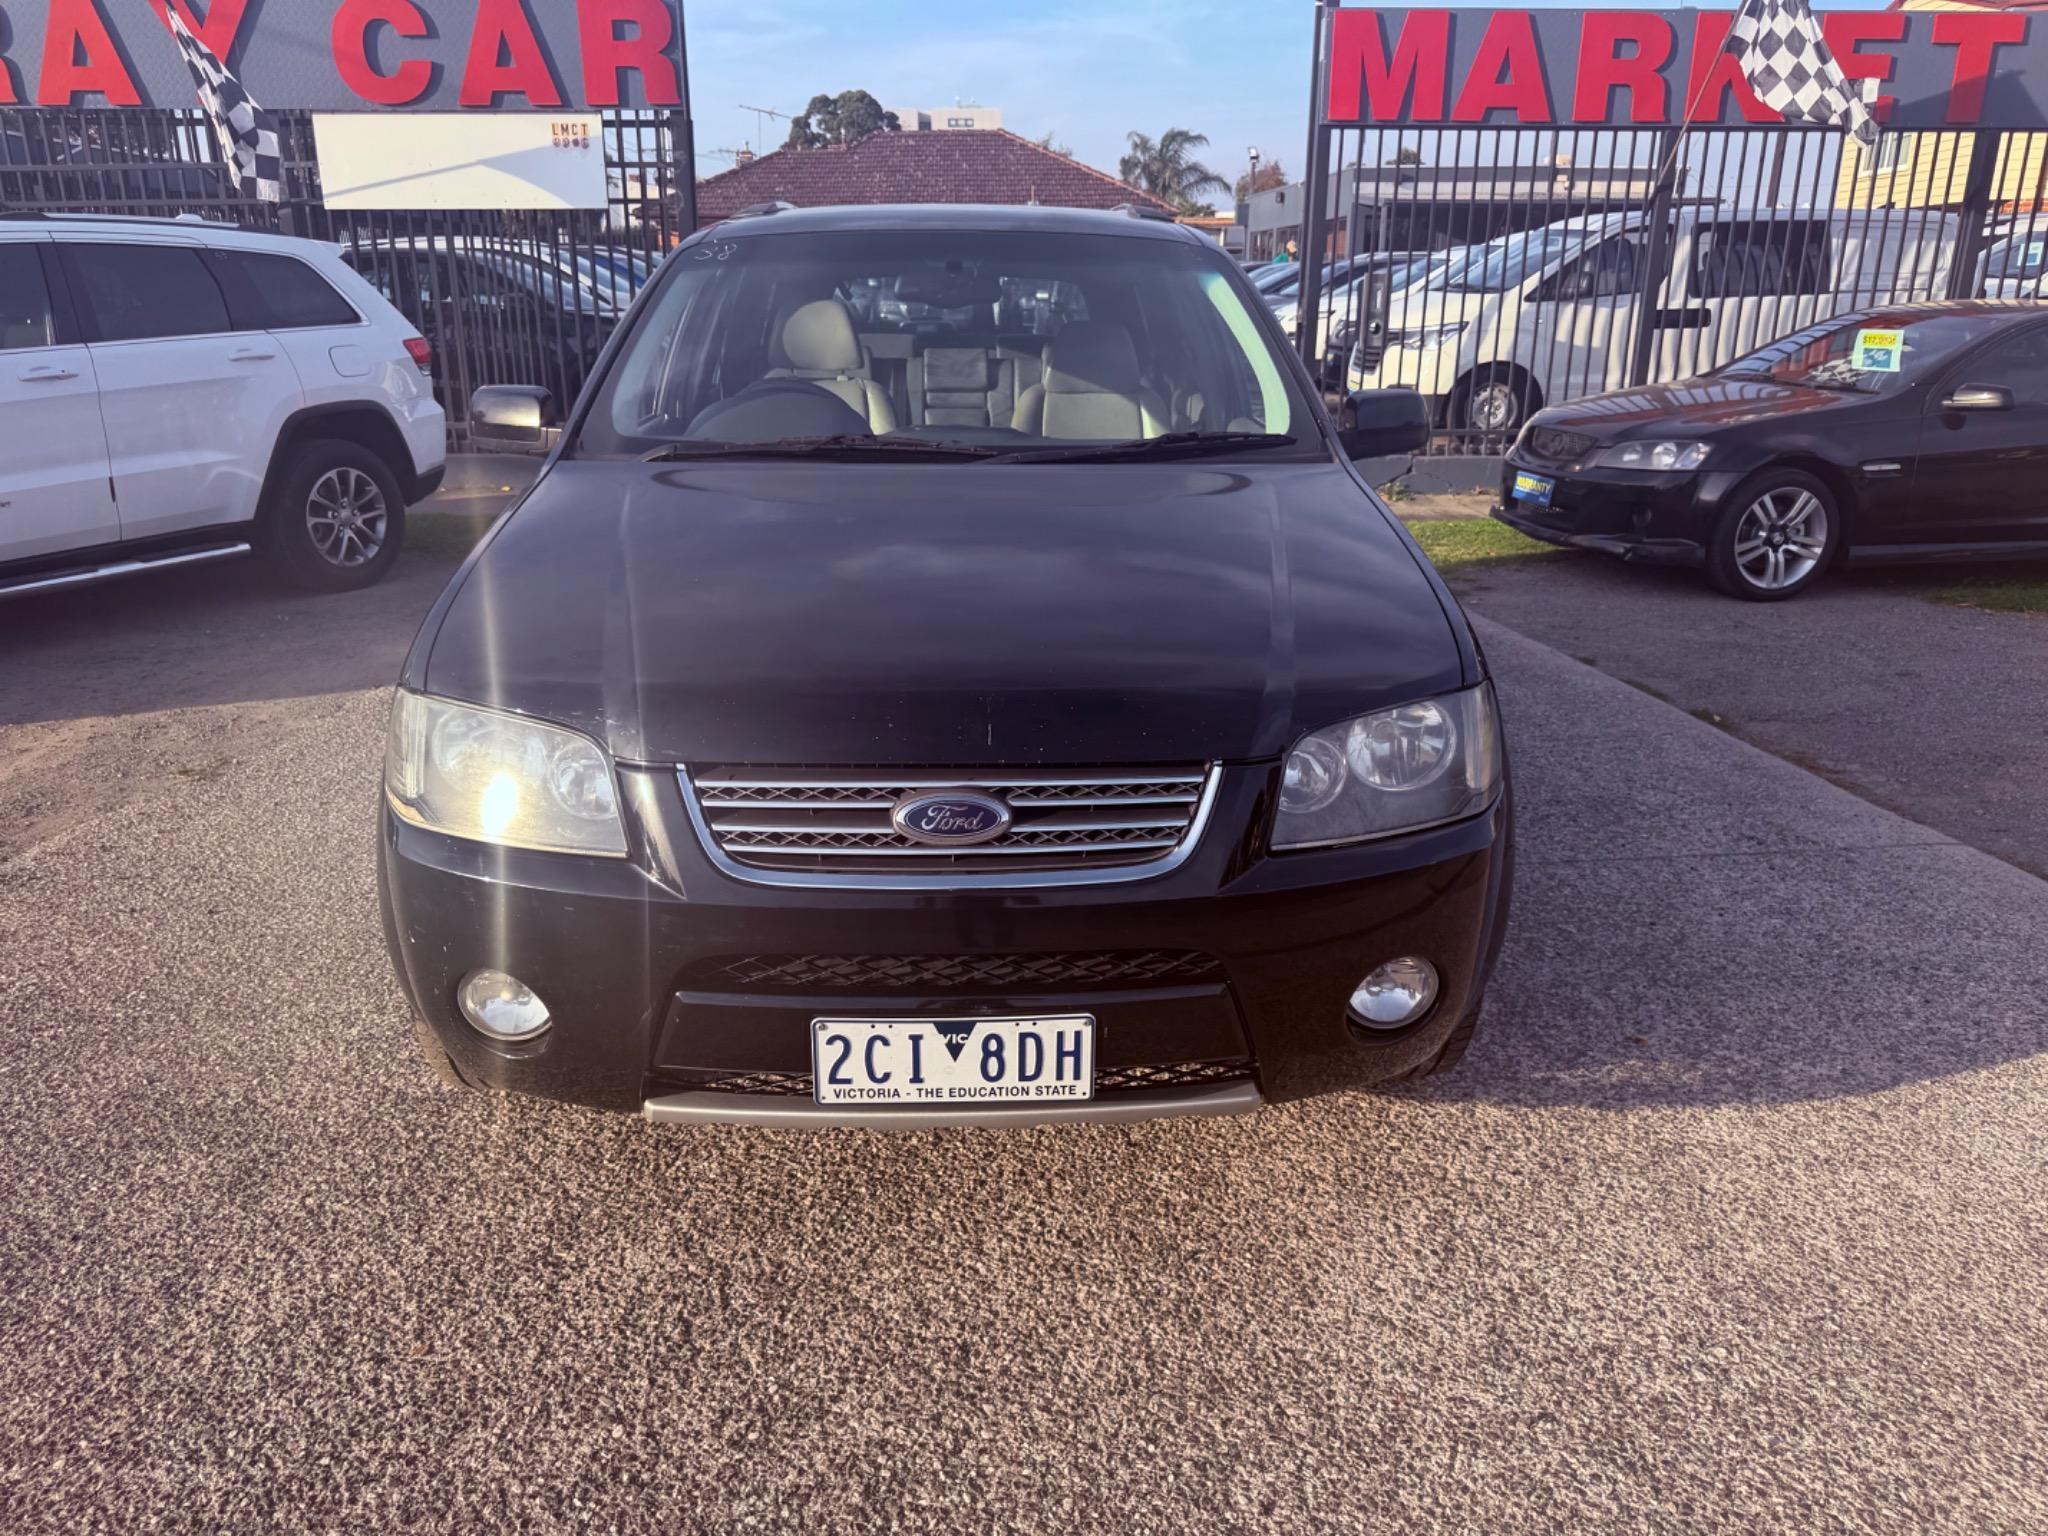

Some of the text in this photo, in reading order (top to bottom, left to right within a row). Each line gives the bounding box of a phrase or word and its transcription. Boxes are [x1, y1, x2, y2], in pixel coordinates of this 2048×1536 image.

[0, 0, 681, 106] AY CAR
[1328, 10, 2026, 122] MARKET
[551, 122, 589, 136] LMCT
[921, 804, 984, 830] Ford
[943, 1033, 969, 1044] VIC
[825, 1029, 1082, 1084] 2CI 8DH
[833, 1088, 900, 1099] VICTORIA
[917, 1087, 943, 1098] THE
[949, 1086, 1030, 1098] EDUCATION
[1035, 1085, 1077, 1096] STATE
